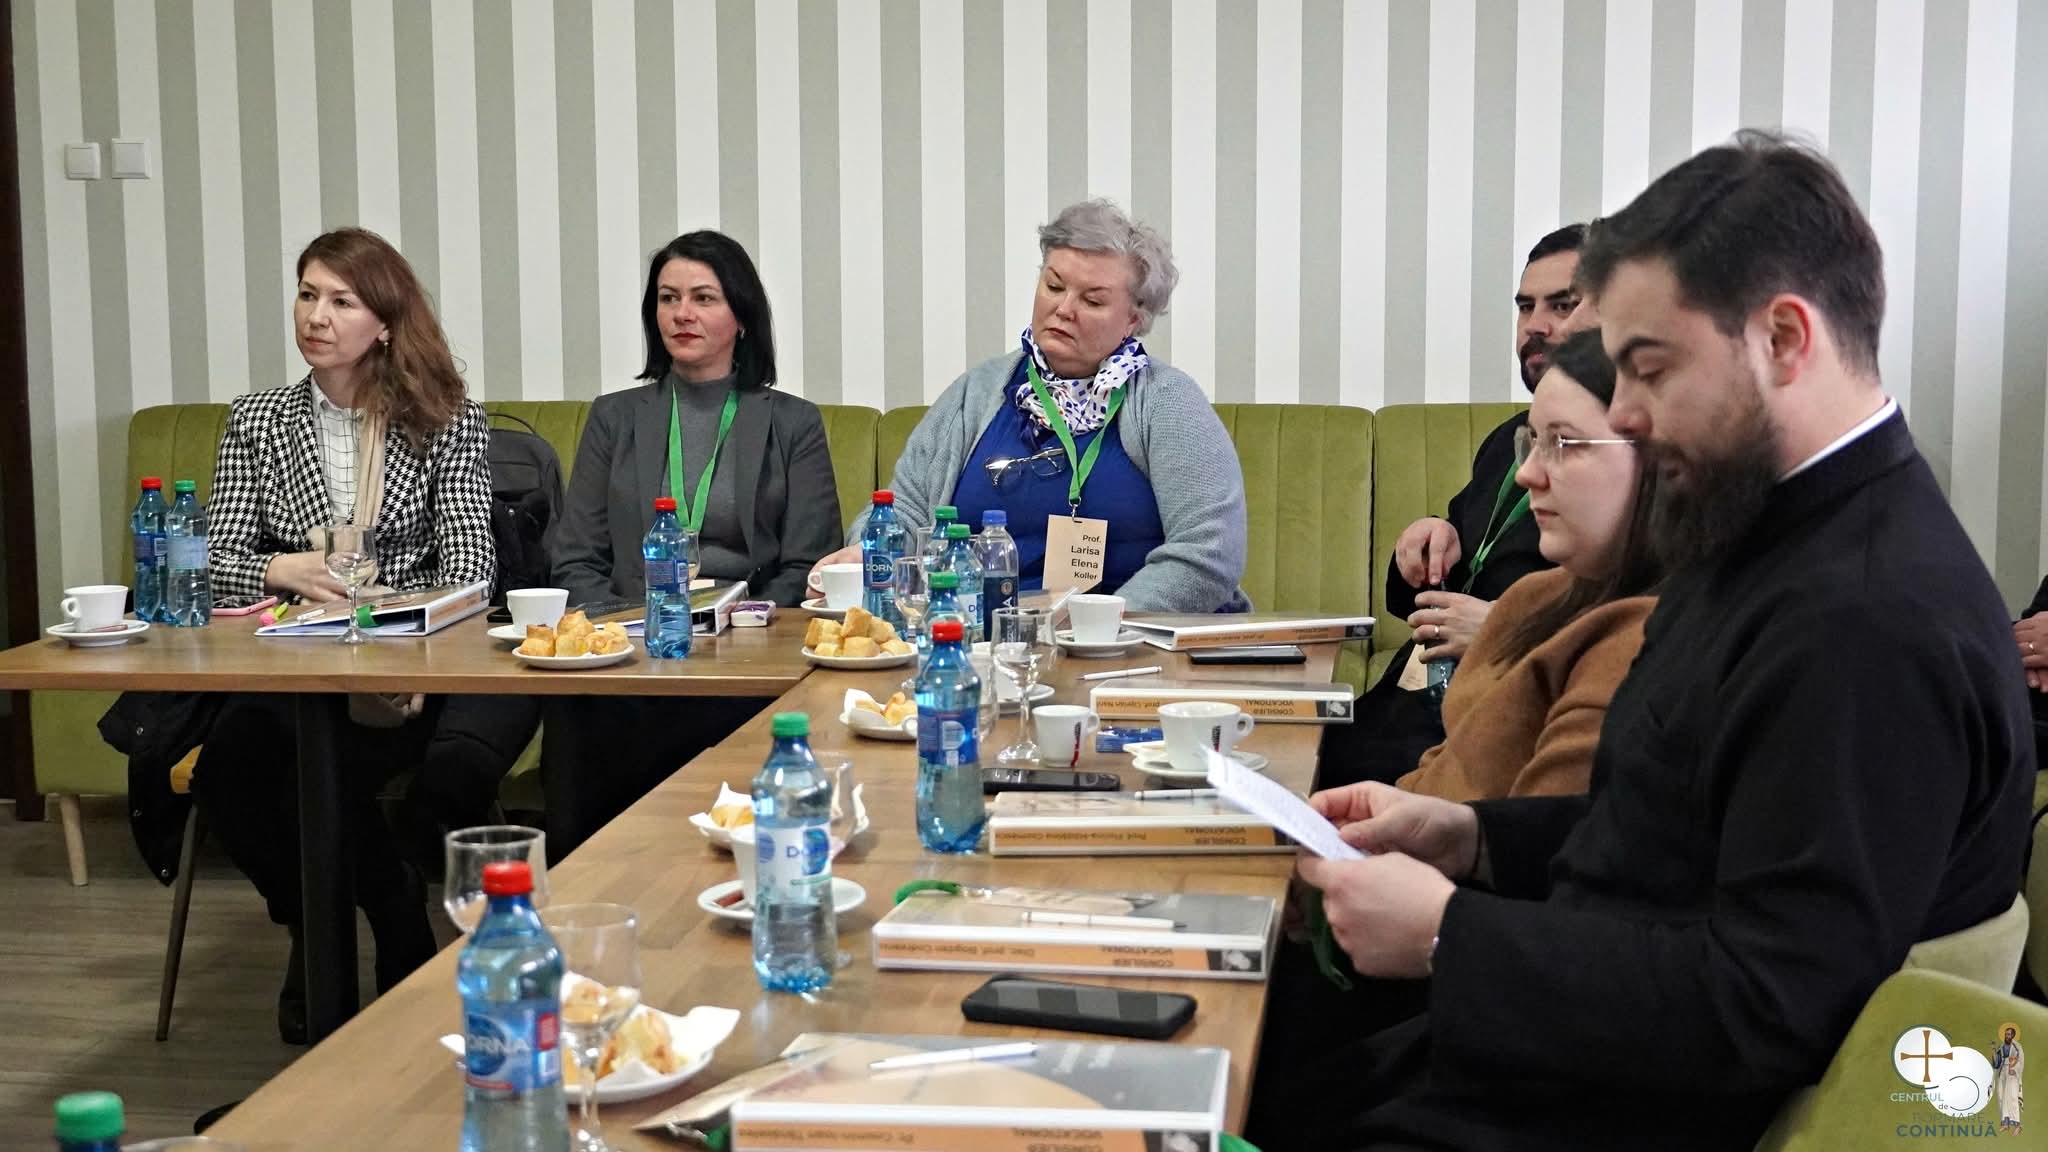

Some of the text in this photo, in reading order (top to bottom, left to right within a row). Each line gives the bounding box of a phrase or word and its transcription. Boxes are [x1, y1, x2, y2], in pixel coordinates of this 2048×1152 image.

[1083, 534, 1102, 543] Prof.
[1071, 545, 1100, 556] Larisa
[1071, 558, 1098, 569] Elena
[1074, 571, 1098, 580] Koller
